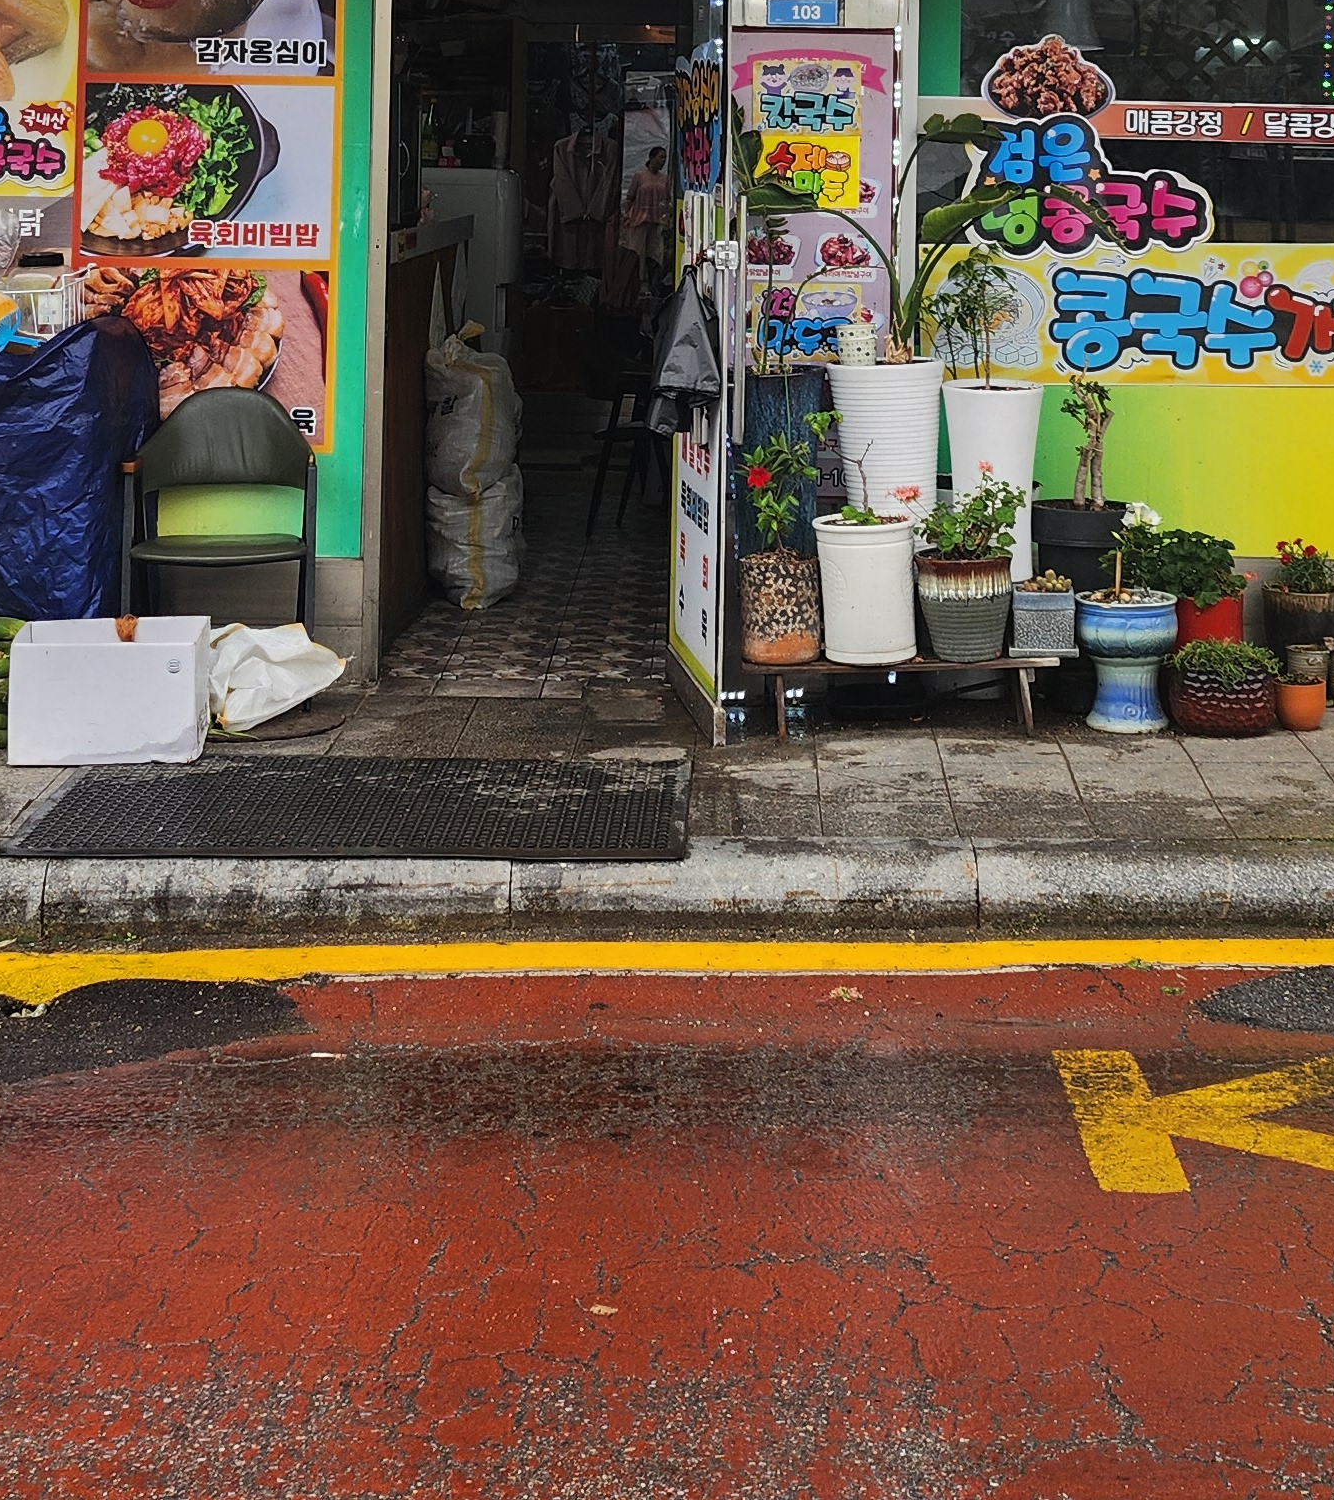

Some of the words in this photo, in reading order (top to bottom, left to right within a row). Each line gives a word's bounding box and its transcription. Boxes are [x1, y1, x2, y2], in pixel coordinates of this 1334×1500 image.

[791, 5, 821, 20] 103
[196, 37, 328, 68] 감자옹심이
[21, 111, 67, 131] 국내산
[761, 91, 855, 132] 칼국수
[1124, 110, 1223, 137] 매콤강정
[768, 141, 828, 179] 수제
[988, 122, 1091, 184] 검은
[792, 168, 850, 202] 만두
[188, 220, 320, 249] 육회비빔밥
